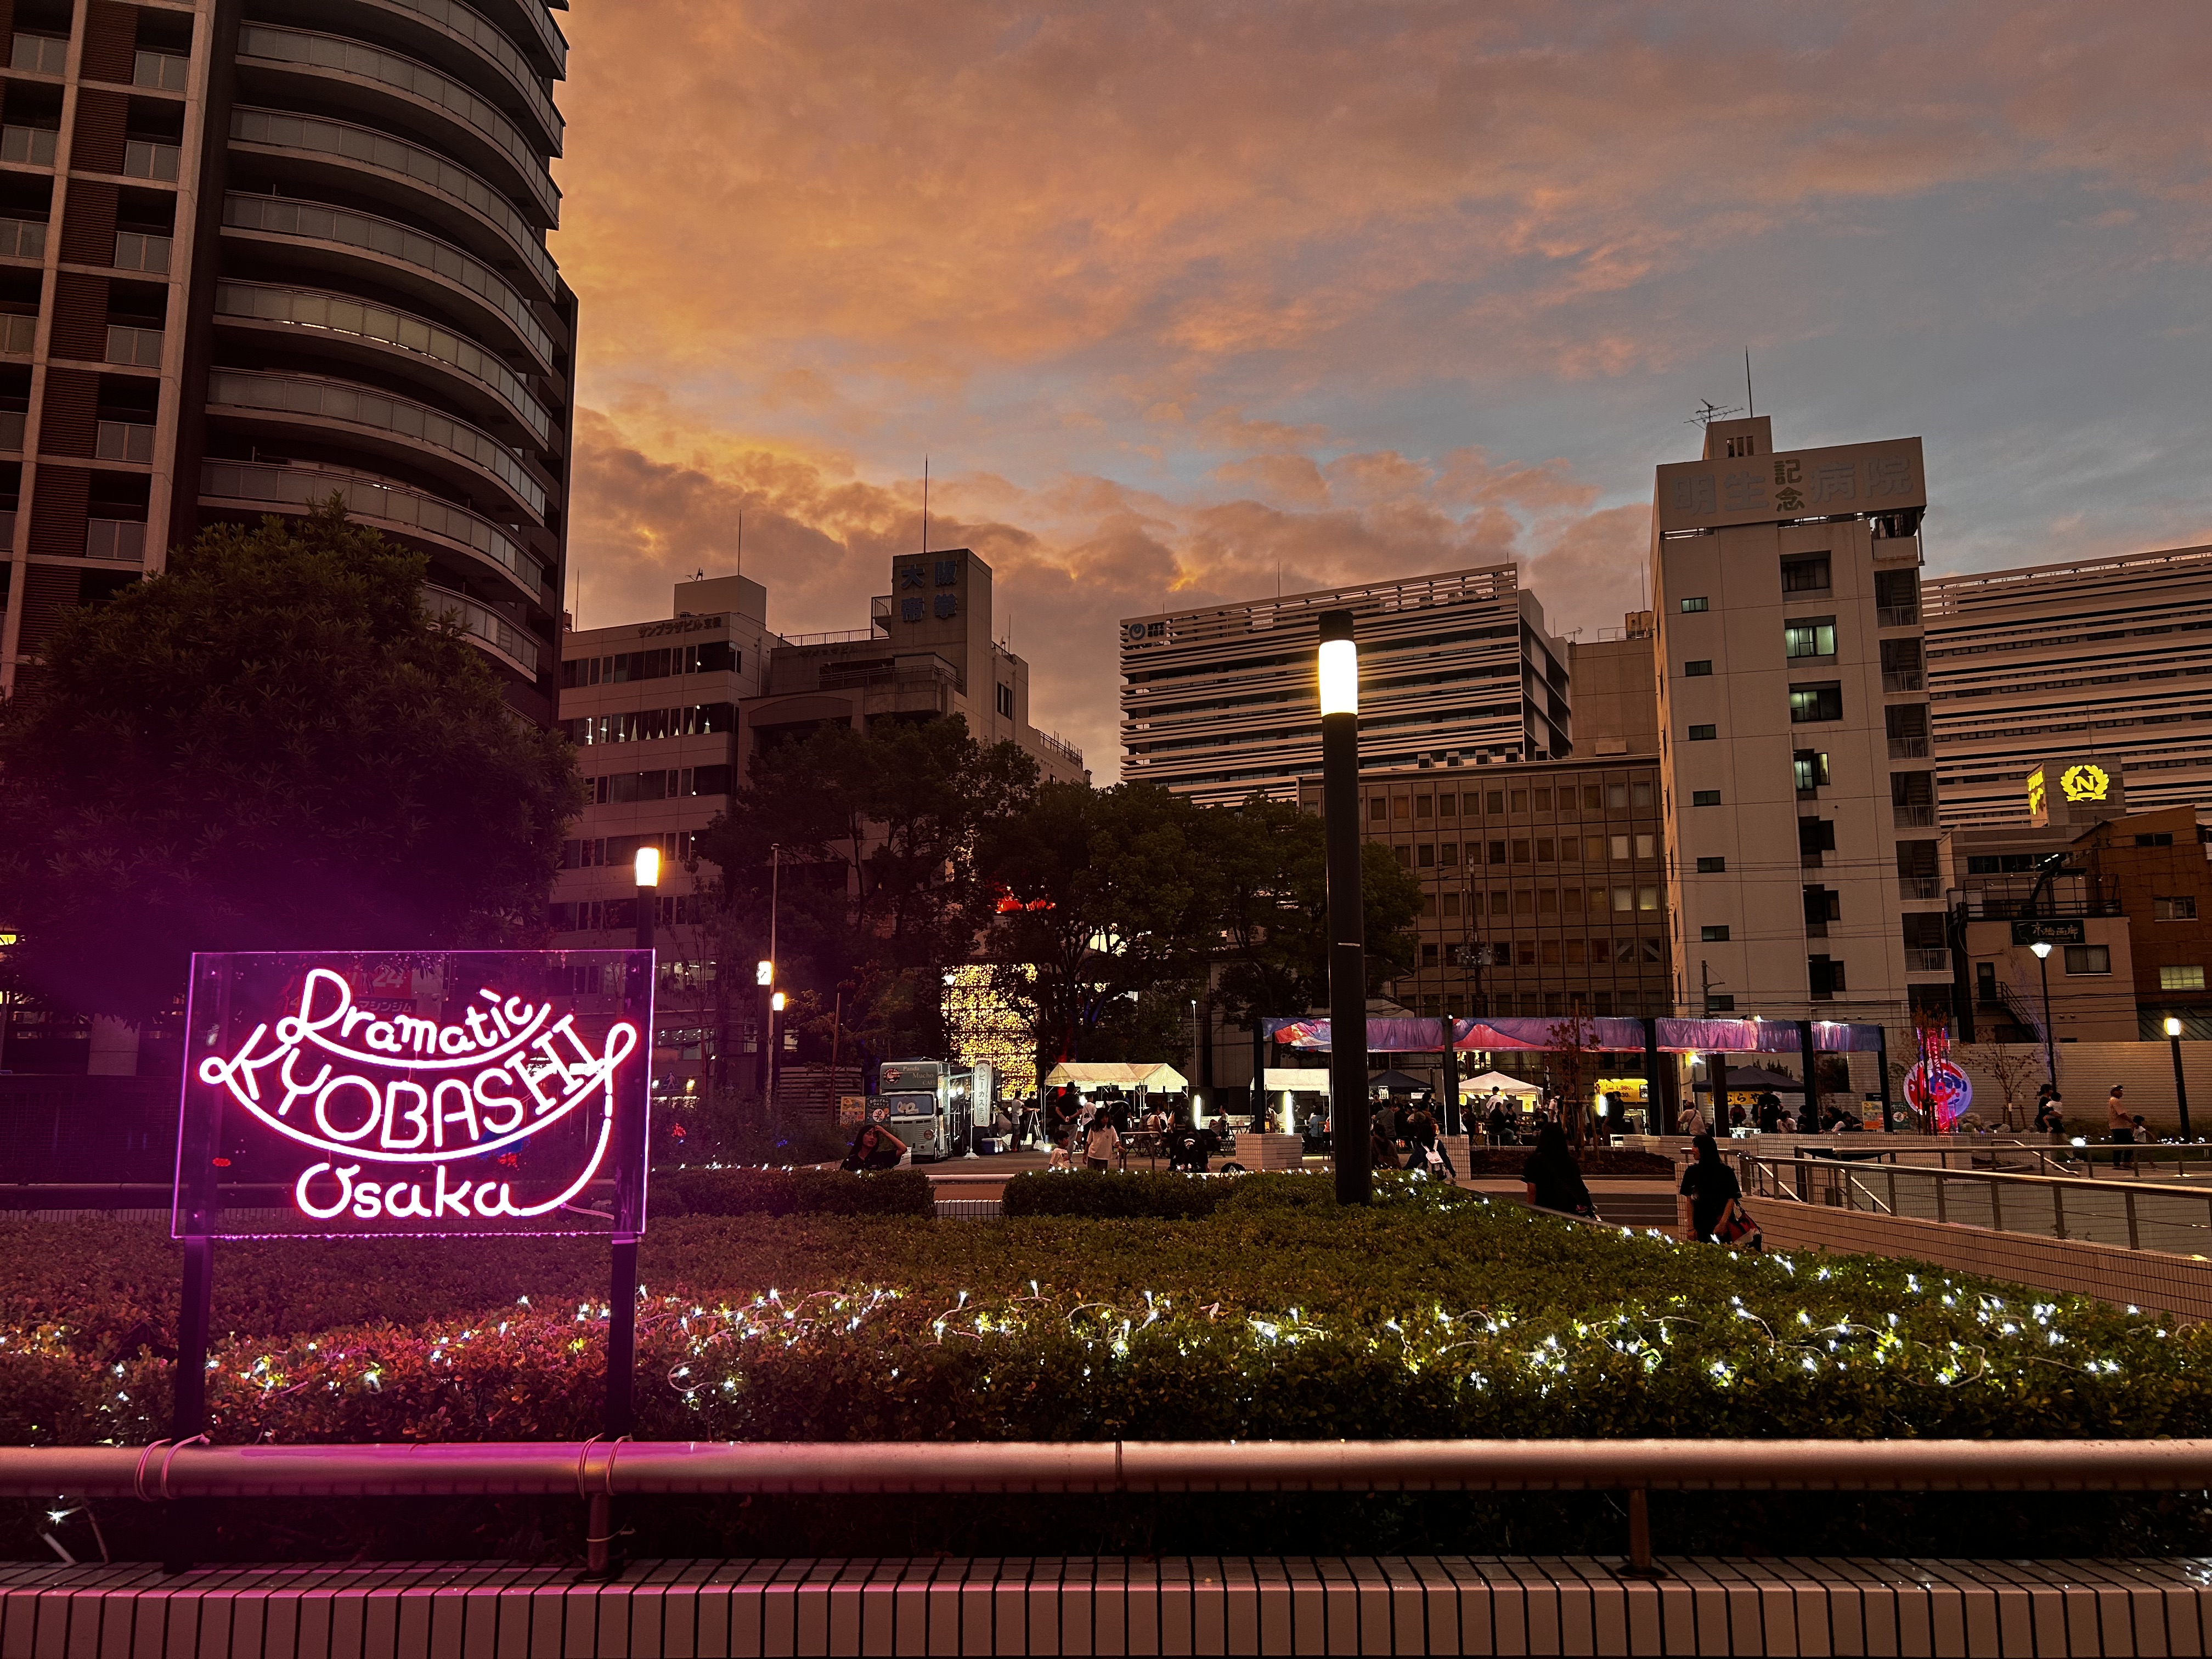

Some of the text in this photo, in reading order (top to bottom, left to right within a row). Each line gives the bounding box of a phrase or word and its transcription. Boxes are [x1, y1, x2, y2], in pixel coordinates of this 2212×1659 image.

[1671, 455, 1913, 516] 明生記念病院
[901, 560, 957, 589] 大阪
[901, 593, 957, 622] 帝拳
[2075, 776, 2095, 792] N
[277, 968, 540, 1065] Dramatic
[204, 1015, 610, 1150] KYOBASHI
[978, 1066, 986, 1122] ベビーカステラ
[295, 1162, 526, 1219] Osaka
